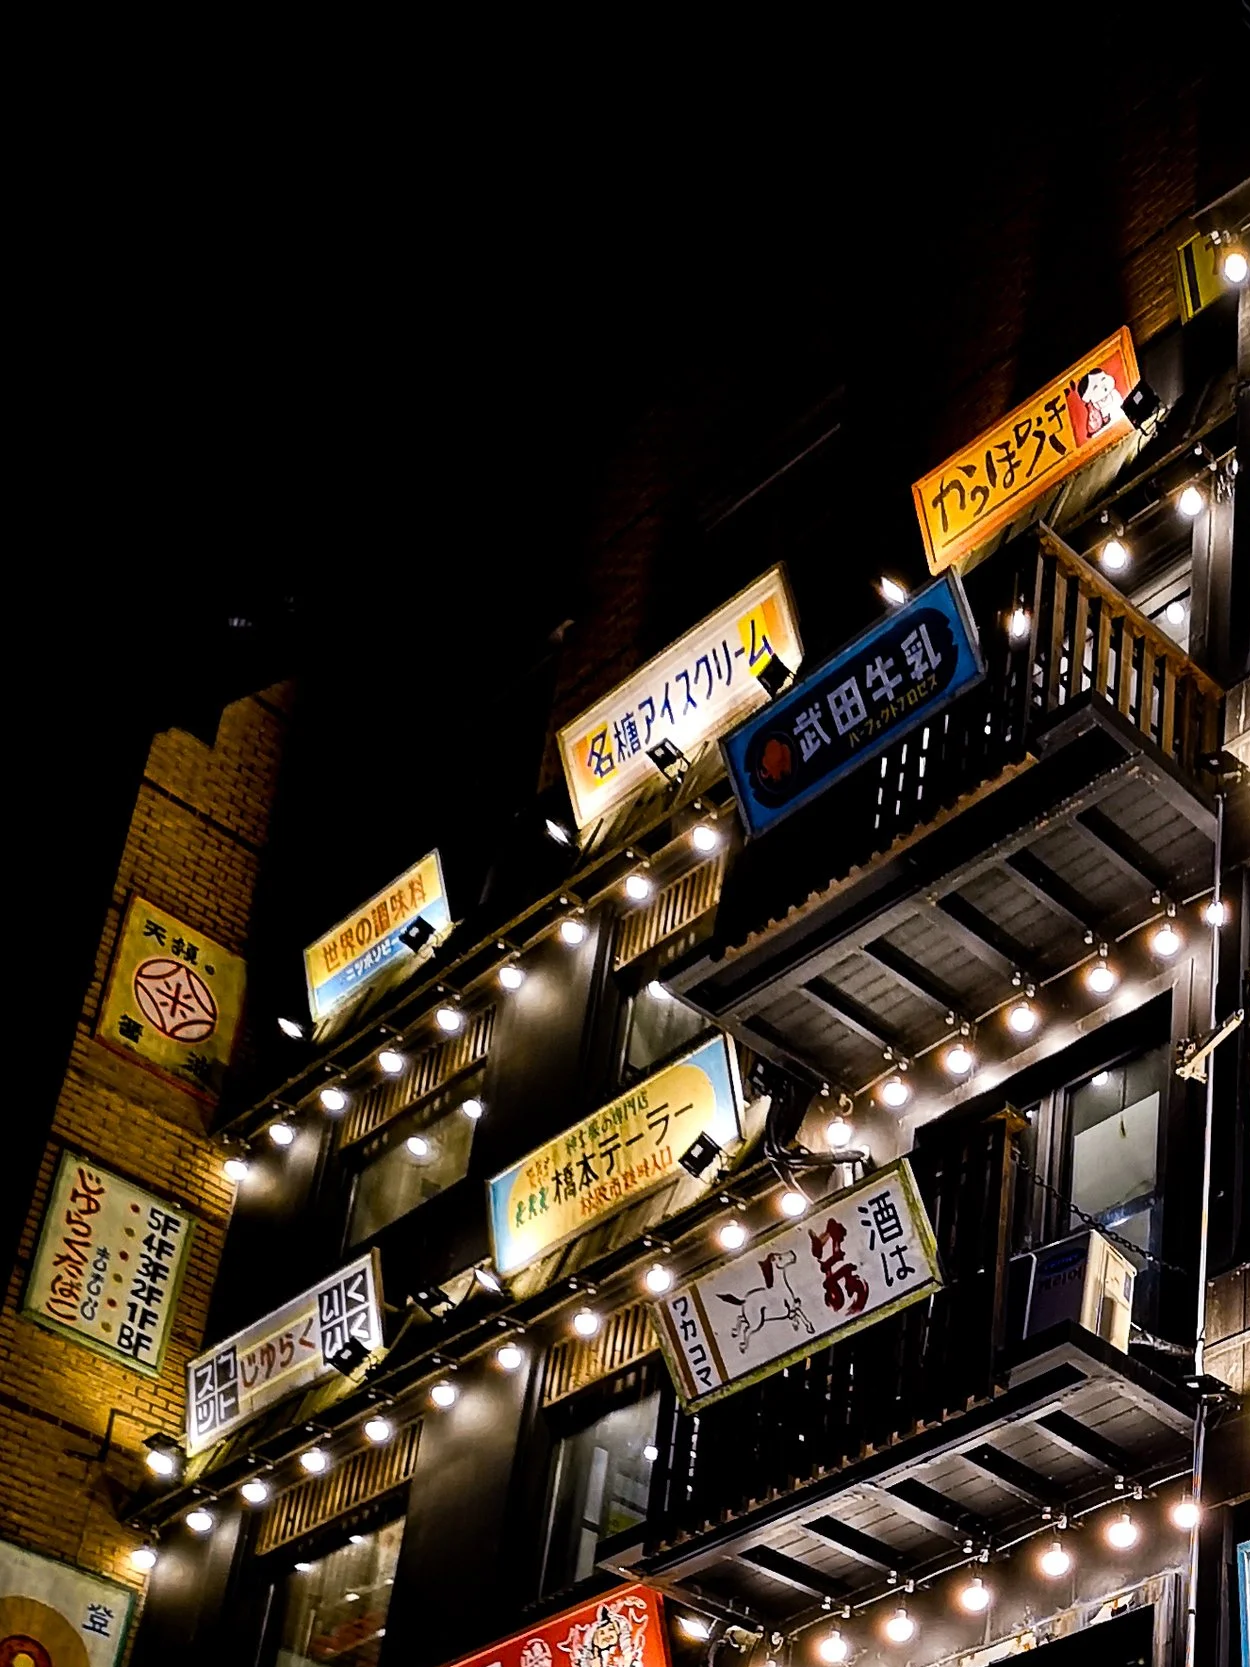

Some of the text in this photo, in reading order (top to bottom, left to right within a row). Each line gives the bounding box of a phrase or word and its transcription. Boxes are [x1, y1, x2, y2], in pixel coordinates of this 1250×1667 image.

[793, 623, 942, 762] 武田牛乳
[552, 1103, 693, 1205] 橋本テーラー
[148, 1207, 181, 1237] 5F
[858, 1190, 915, 1287] 酒は
[142, 1233, 176, 1260] 4F
[136, 1253, 170, 1284] 3F
[130, 1279, 164, 1307] 2F
[127, 1302, 159, 1331] 1F
[117, 1323, 152, 1359] BF
[672, 1296, 712, 1387] ワカコマ
